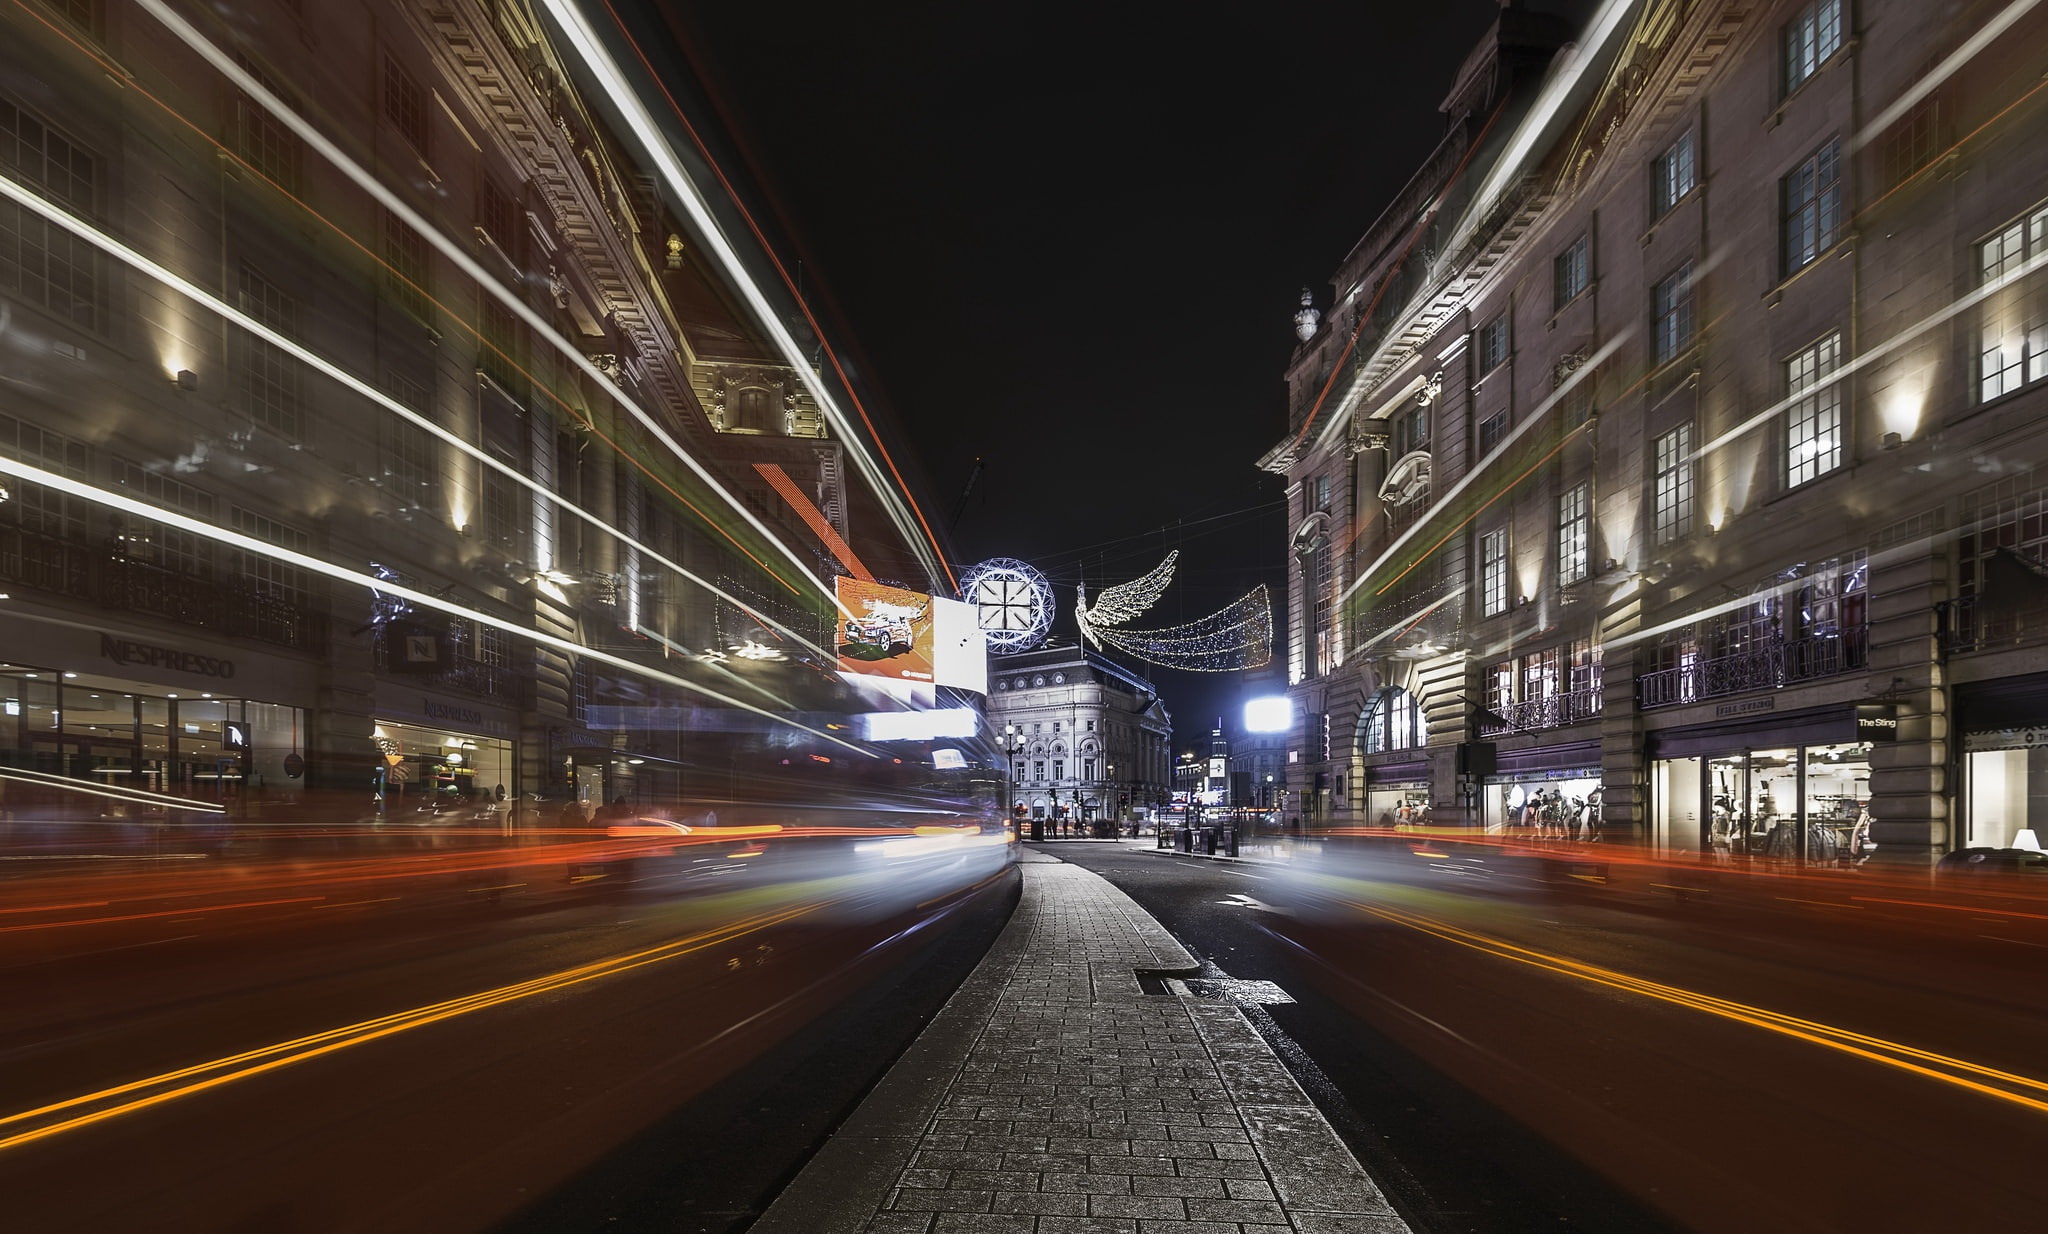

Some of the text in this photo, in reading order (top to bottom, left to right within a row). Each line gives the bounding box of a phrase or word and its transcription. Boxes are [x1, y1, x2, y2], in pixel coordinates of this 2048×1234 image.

[99, 632, 235, 678] NESPRESSO
[424, 697, 481, 723] NESPRESSO
[1858, 718, 1896, 729] The Sting
